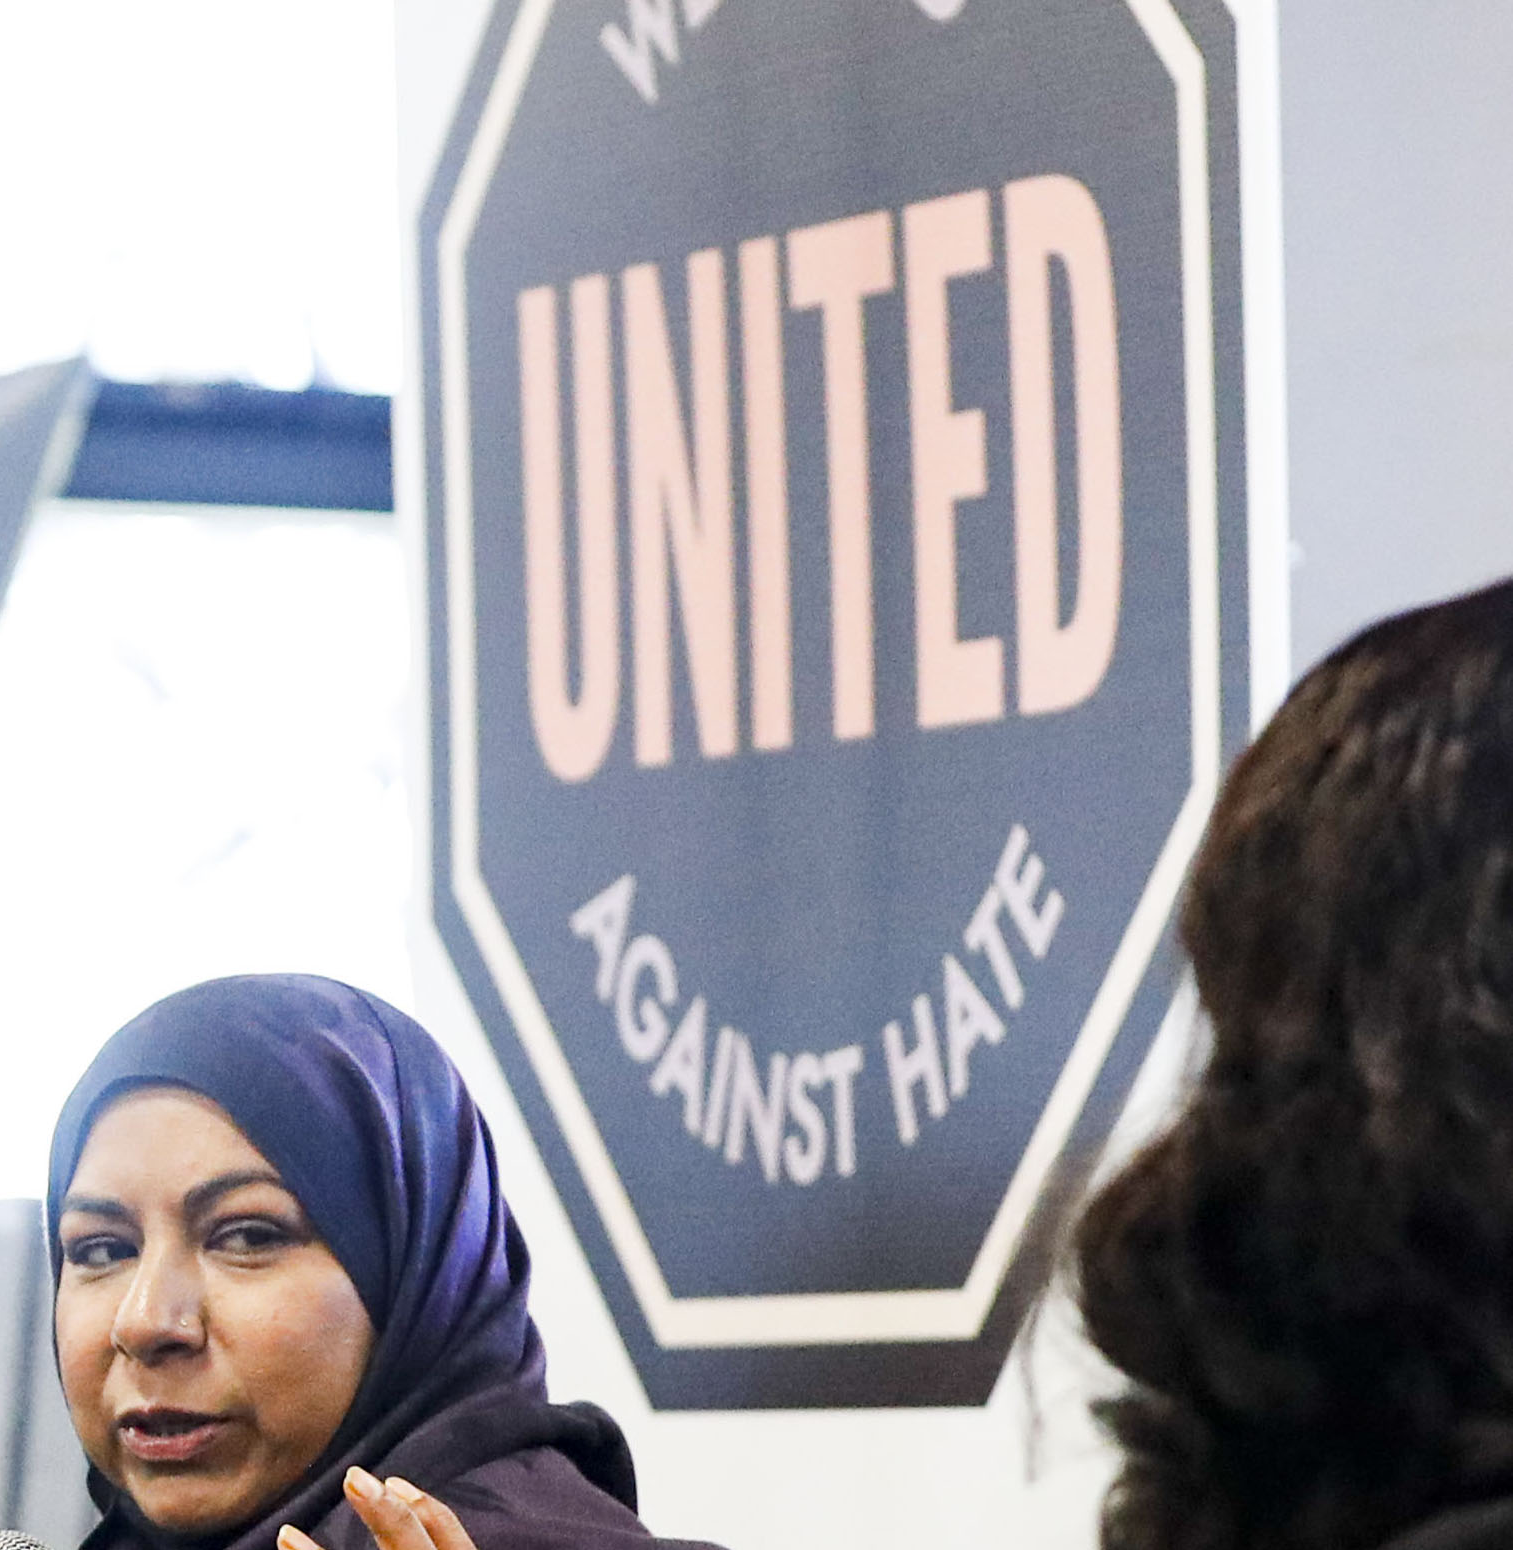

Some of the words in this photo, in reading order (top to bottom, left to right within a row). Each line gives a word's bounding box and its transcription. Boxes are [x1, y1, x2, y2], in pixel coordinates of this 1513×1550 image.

[517, 172, 1125, 786] UNITED
[569, 874, 864, 1187] AGAINST
[883, 823, 1067, 1146] HATE
